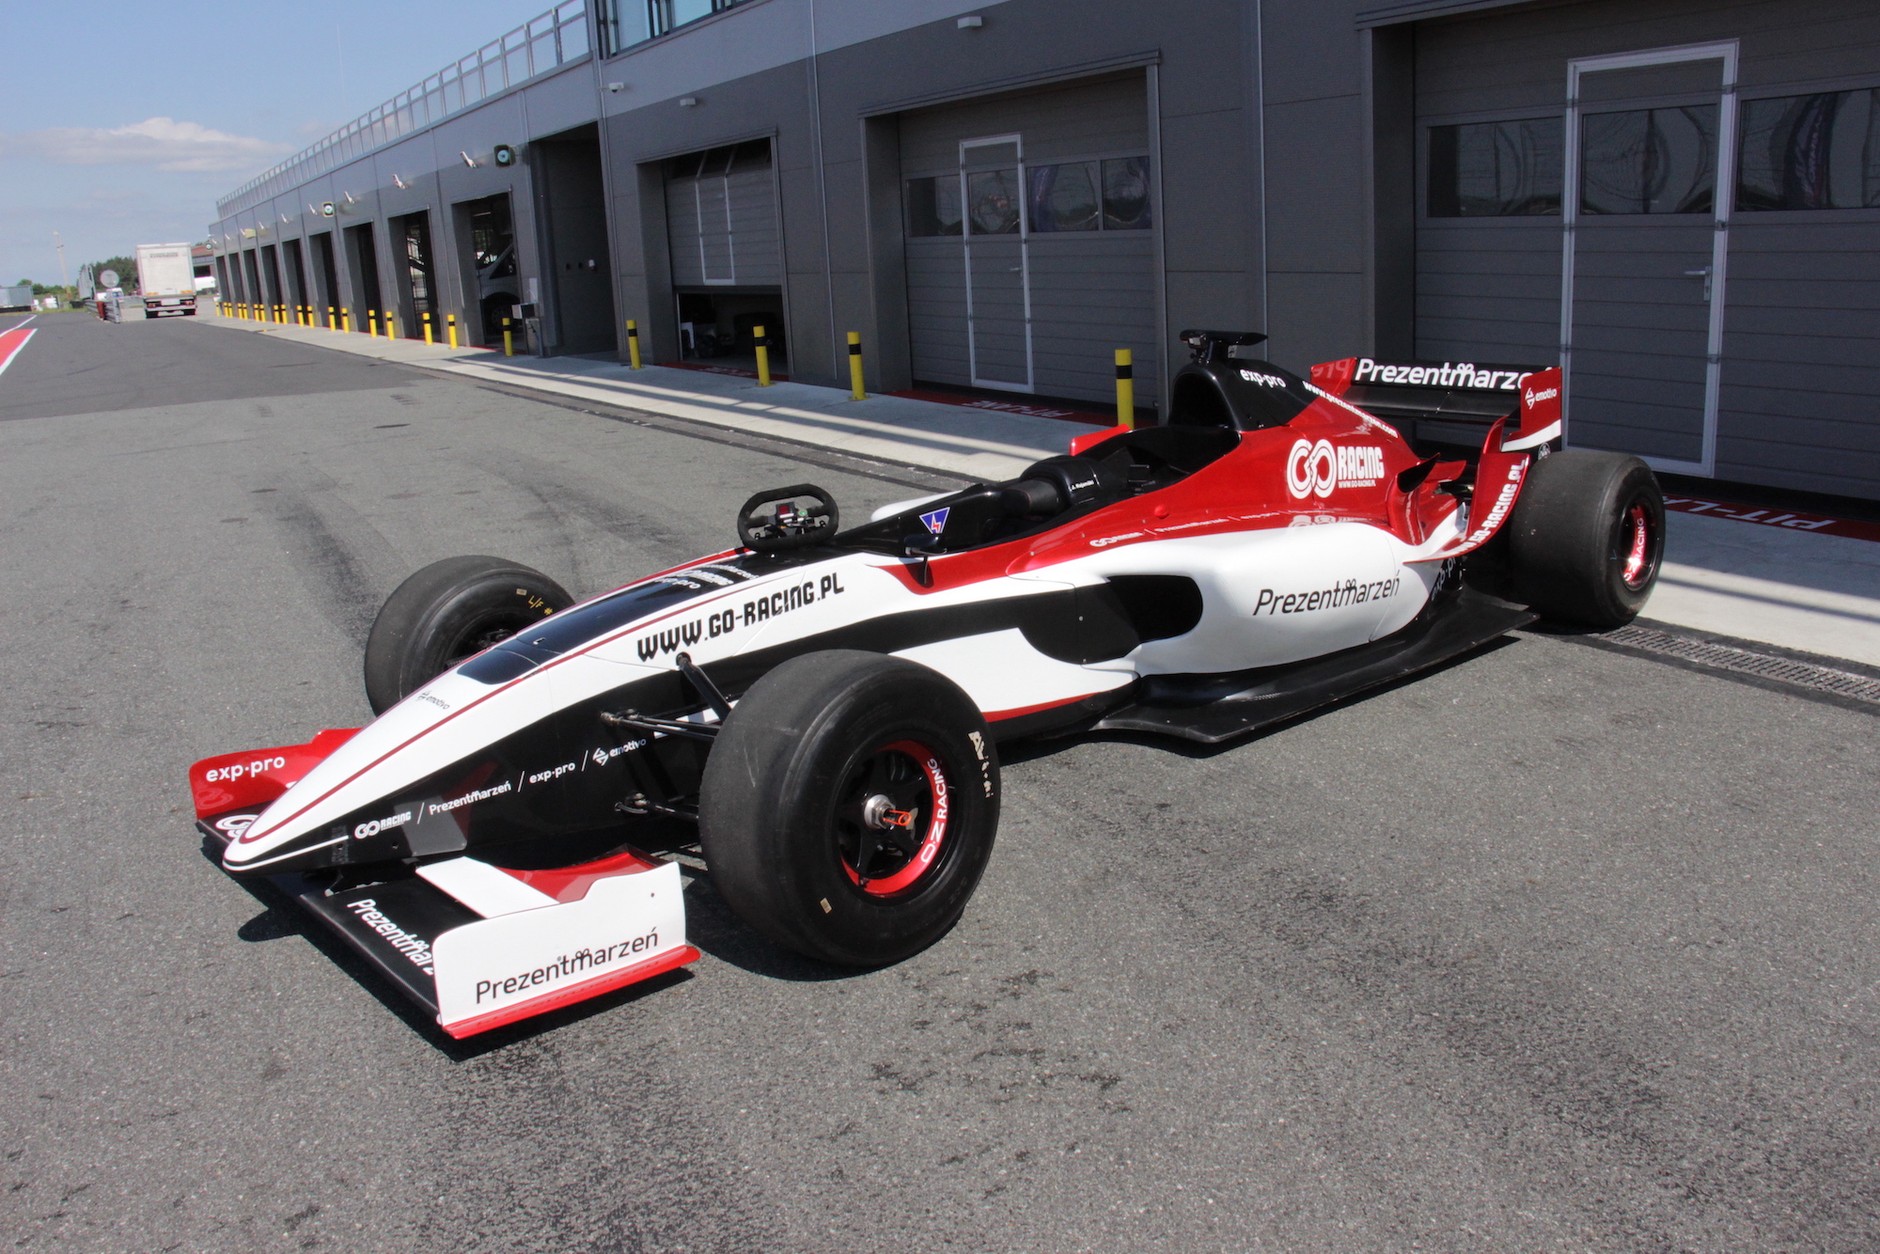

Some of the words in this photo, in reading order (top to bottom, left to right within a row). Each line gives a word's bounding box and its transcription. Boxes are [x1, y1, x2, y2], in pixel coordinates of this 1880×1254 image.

[1355, 358, 1533, 390] Prezentmarz
[1286, 438, 1337, 500] GO
[1337, 445, 1385, 480] RACING
[1662, 496, 1837, 530] PIT-LA
[637, 572, 845, 663] WWW.GO-RACING.PL
[1252, 569, 1401, 616] Prezentmarzeń
[354, 820, 380, 839] GO
[380, 811, 411, 829] RACING
[428, 781, 512, 816] Prezentmarzeń
[609, 738, 647, 757] emotivo
[927, 758, 949, 819] RACING
[346, 898, 435, 976] Prezentmarz
[475, 927, 659, 1004] Prezentmarzeń
